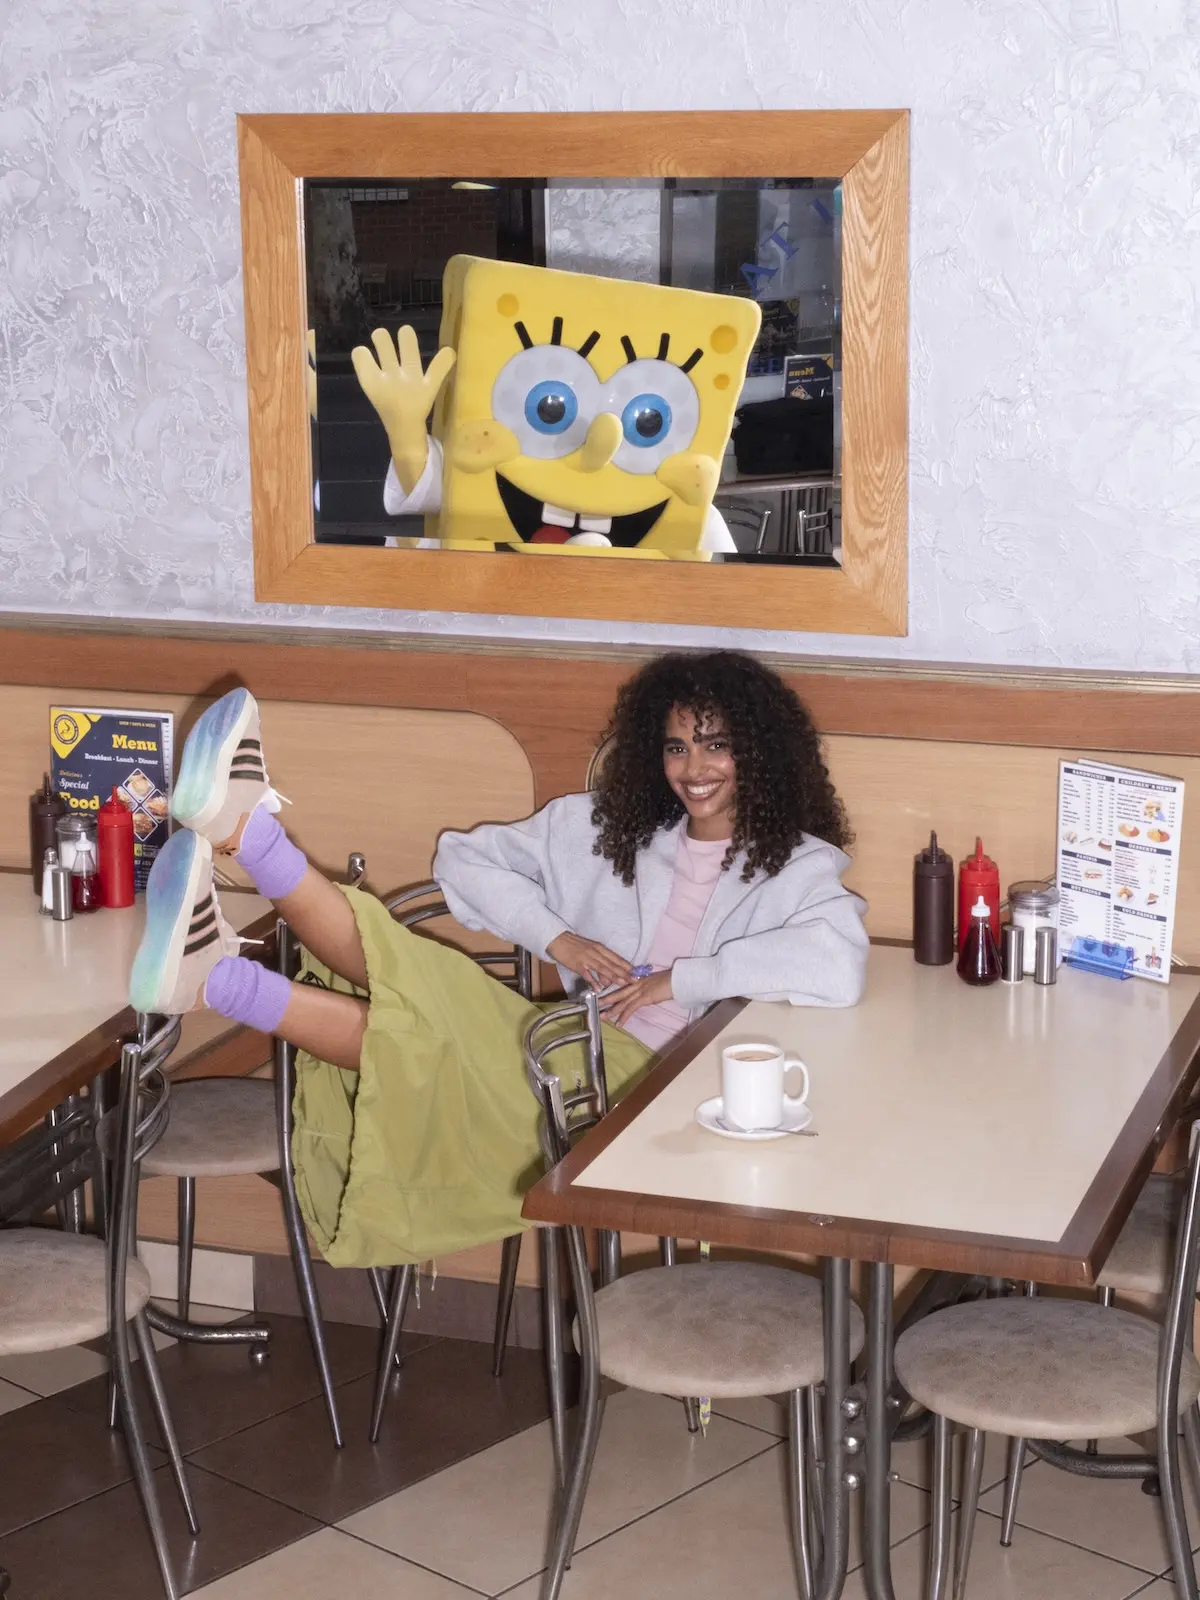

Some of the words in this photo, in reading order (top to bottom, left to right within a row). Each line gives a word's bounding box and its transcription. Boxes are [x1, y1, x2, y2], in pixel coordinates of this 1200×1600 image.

[112, 734, 157, 752] Menu
[84, 753, 112, 762] Breakfast
[1072, 769, 1107, 781] SANDWICHES
[59, 778, 90, 790] Special
[1120, 779, 1155, 789] CHILDREN'S
[1128, 843, 1157, 853] DESSERTS
[1082, 887, 1102, 897] DRINKS
[1121, 908, 1136, 916] COLD
[1136, 911, 1157, 920] DRINKS
